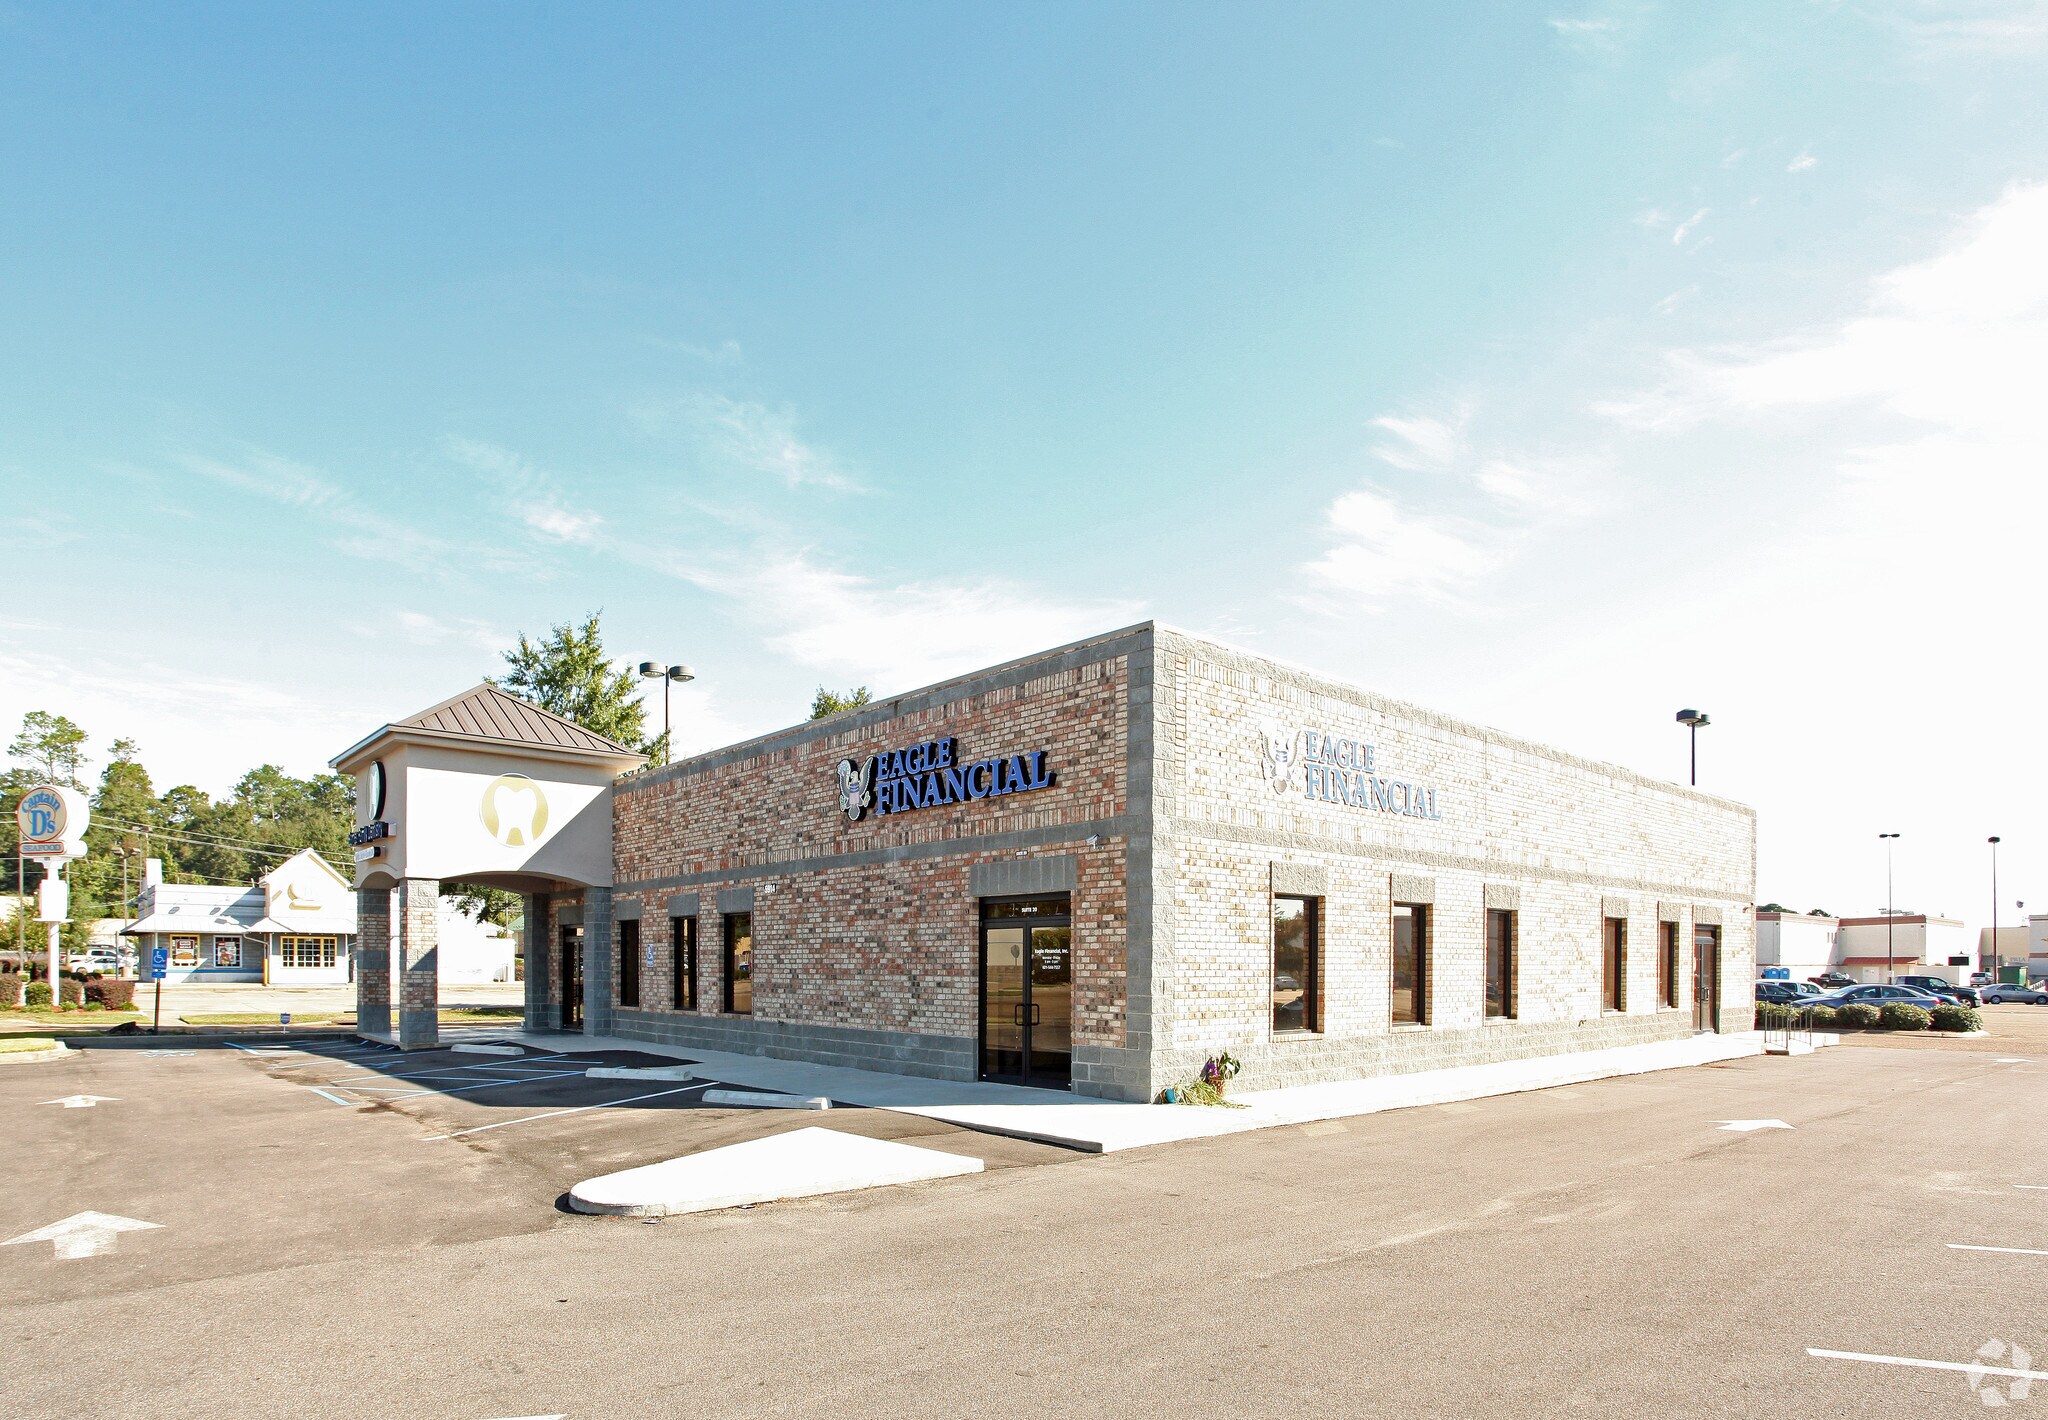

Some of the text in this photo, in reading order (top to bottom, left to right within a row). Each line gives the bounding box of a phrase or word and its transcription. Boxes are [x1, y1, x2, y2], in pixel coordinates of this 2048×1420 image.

[876, 737, 955, 781] EAGLE
[1305, 730, 1375, 773] EAGLE
[21, 790, 60, 813] Captain
[876, 751, 1053, 815] FINANCIAL
[1304, 762, 1442, 820] FINANCIAL
[30, 809, 56, 836] D's
[22, 844, 61, 852] SEAFOOD
